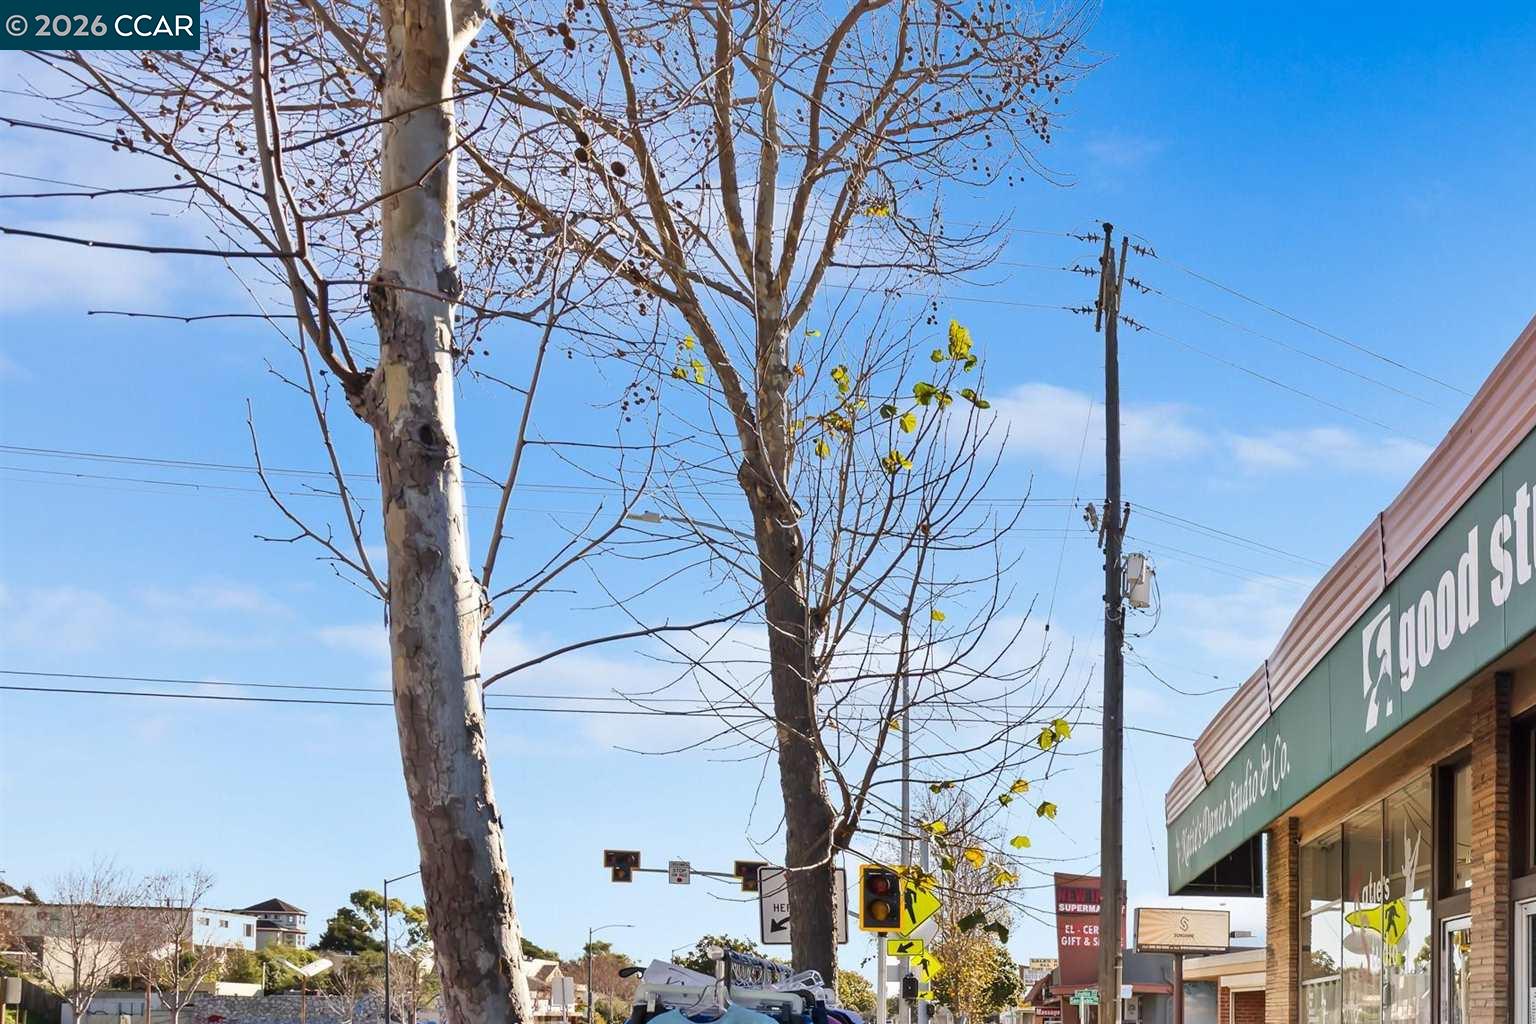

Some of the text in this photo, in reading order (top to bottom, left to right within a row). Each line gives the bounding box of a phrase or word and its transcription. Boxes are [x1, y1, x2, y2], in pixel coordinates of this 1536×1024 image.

[1399, 524, 1480, 693] good
[1202, 799, 1227, 845] Dance
[1227, 758, 1258, 828] Studio
[1259, 743, 1271, 798] &
[1272, 733, 1290, 792] Co.
[1061, 936, 1082, 946] GIFT
[1083, 937, 1091, 947] &
[1065, 924, 1075, 934] EL
